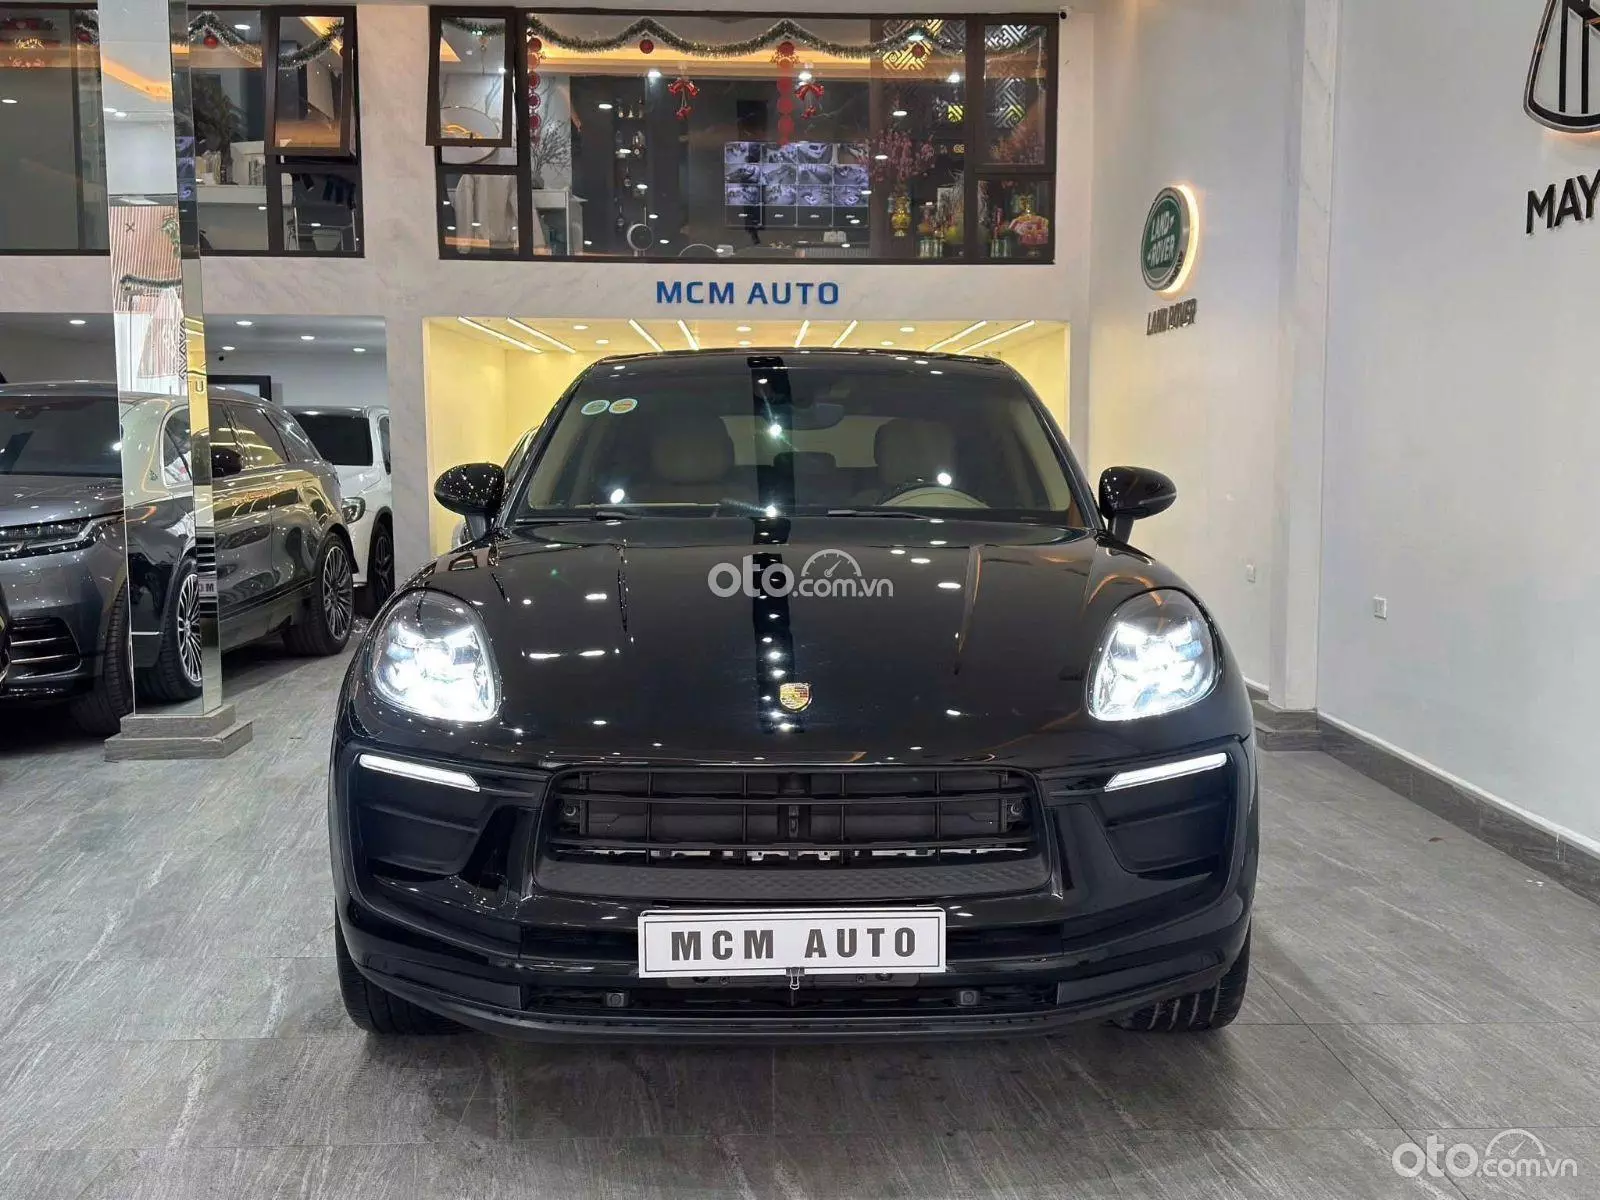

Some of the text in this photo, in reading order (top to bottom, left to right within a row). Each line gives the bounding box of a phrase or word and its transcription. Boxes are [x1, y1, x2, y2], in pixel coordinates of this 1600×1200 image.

[1151, 211, 1170, 242] LAND
[1150, 234, 1175, 267] ROVER
[656, 280, 839, 305] MCM AUTO
[1147, 299, 1197, 335] LAND ROVER
[671, 927, 916, 961] MCM AUTO
